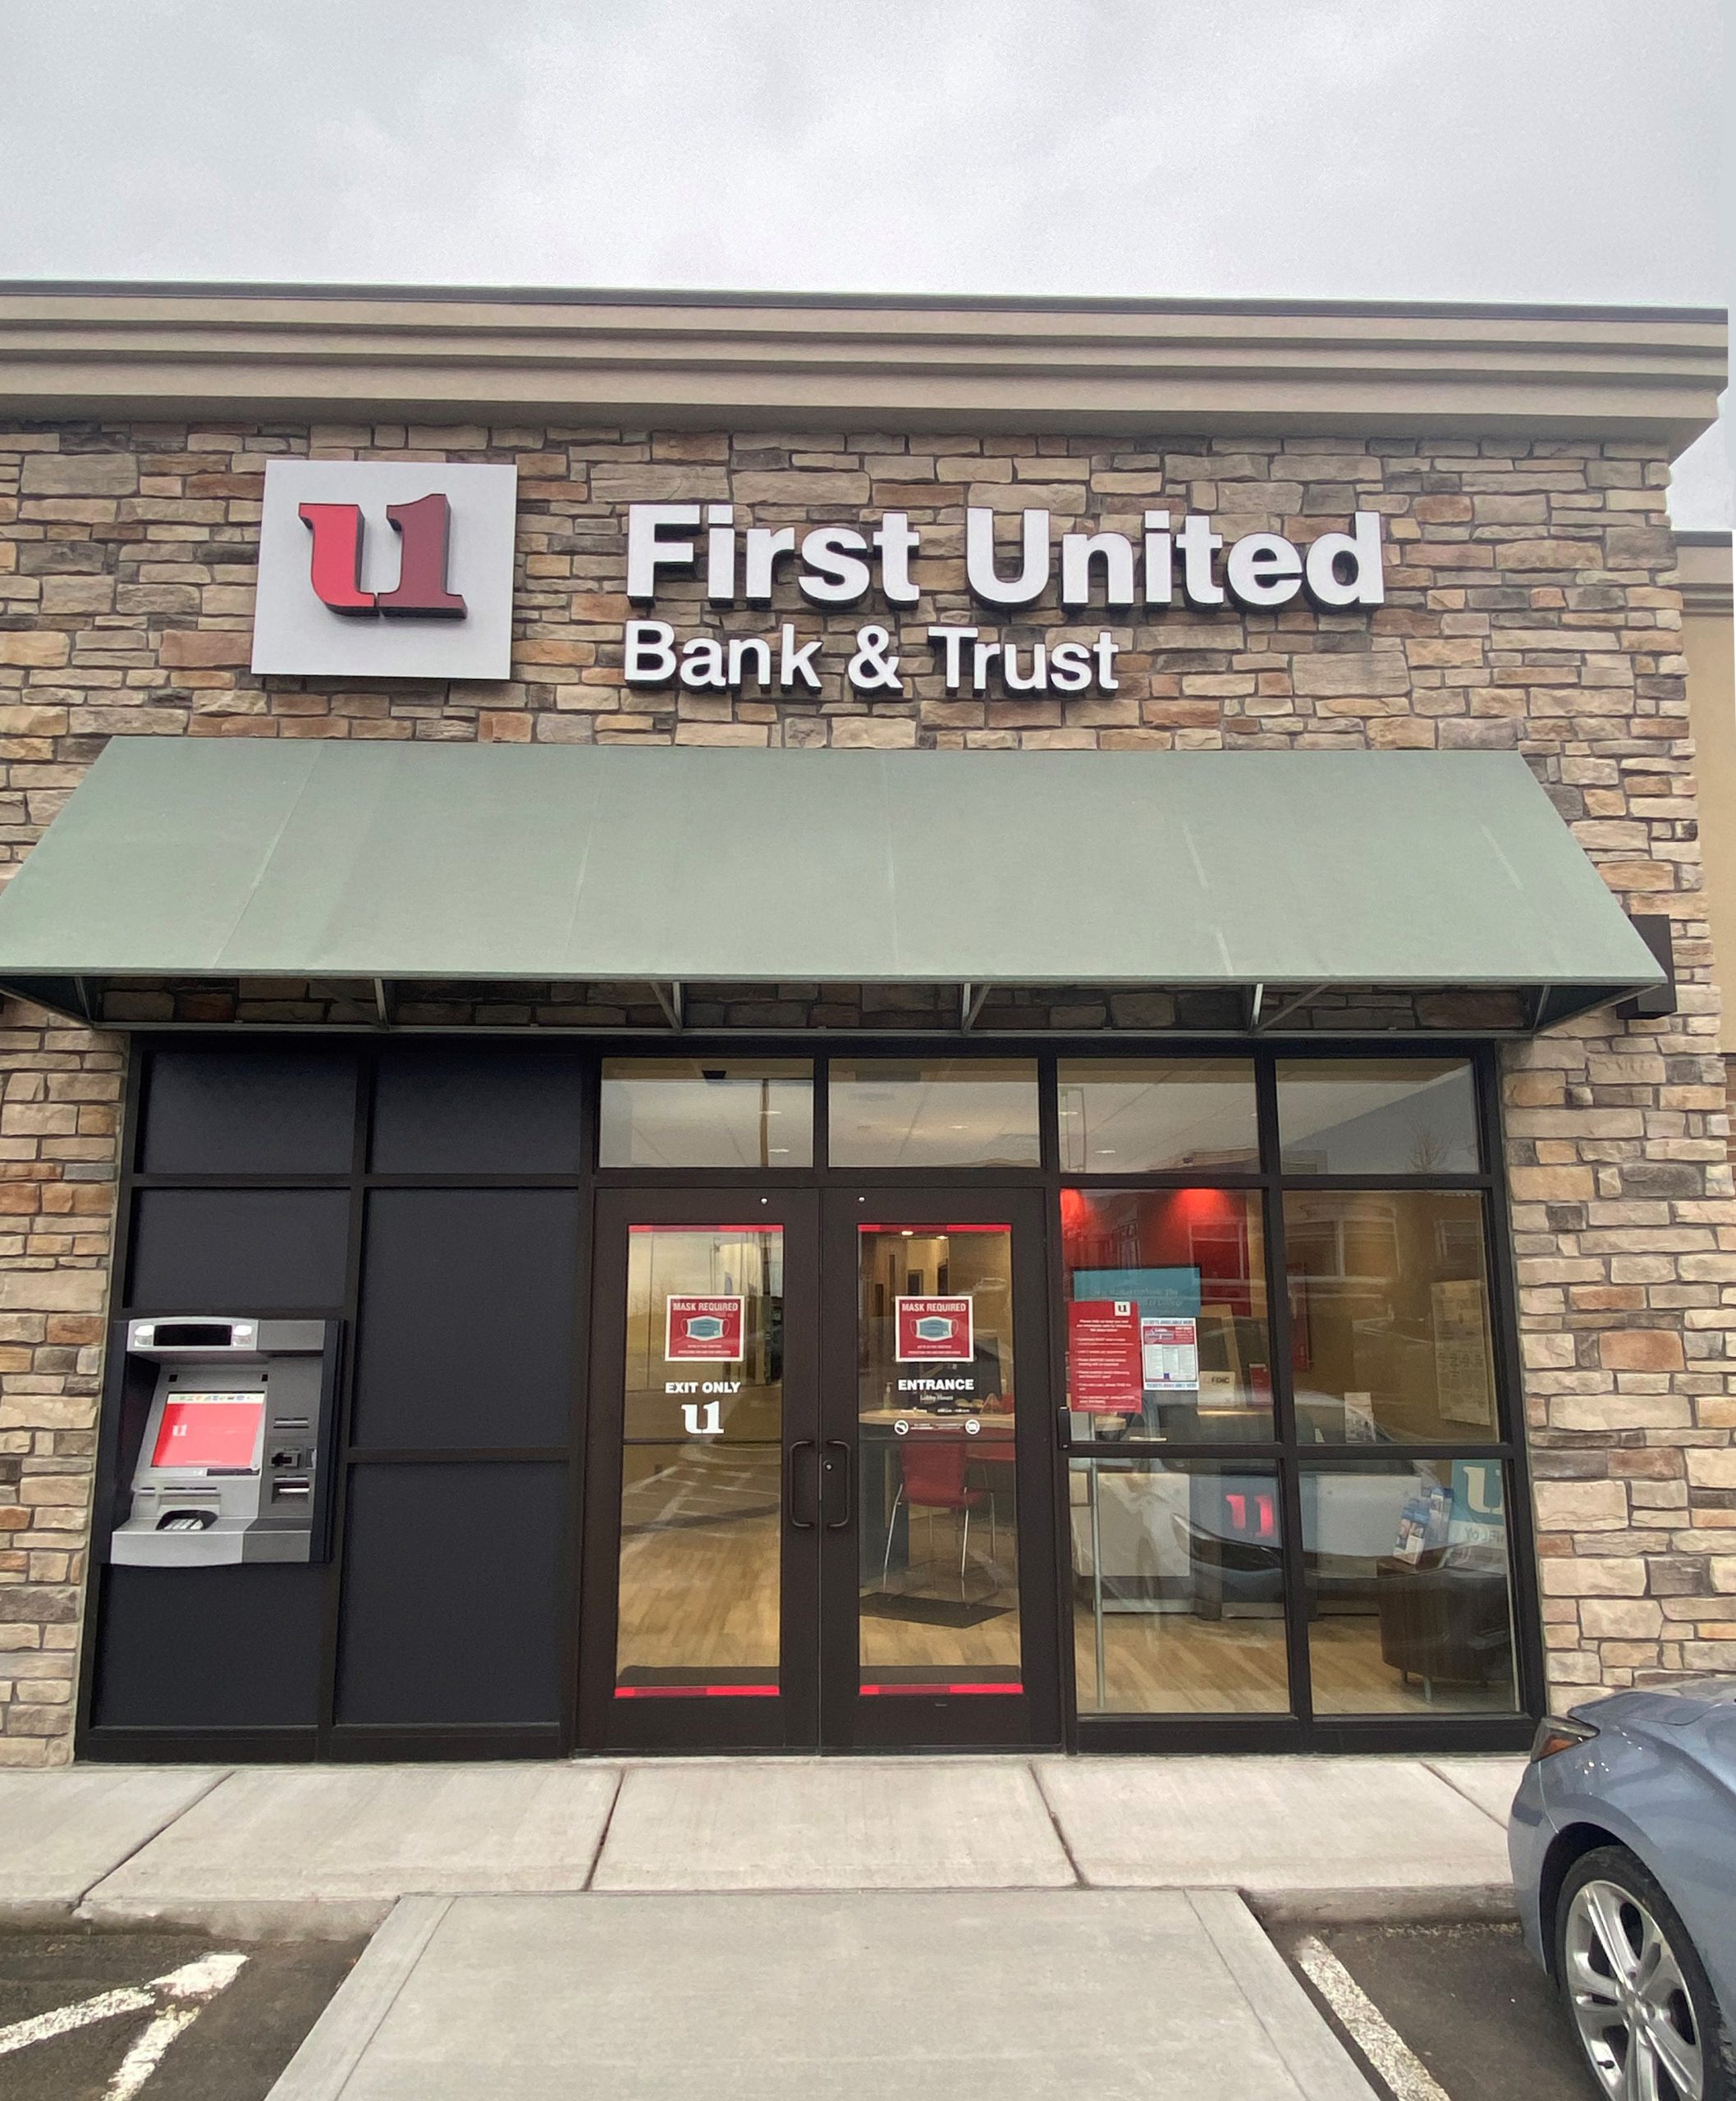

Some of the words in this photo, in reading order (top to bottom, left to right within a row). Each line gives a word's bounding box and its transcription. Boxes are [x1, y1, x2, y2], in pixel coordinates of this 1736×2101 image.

[627, 505, 921, 608] First
[966, 507, 1385, 611] United
[624, 620, 822, 693] Bank
[848, 625, 903, 693] &
[928, 625, 1120, 696] Trust
[673, 1302, 697, 1311] MASK
[698, 1302, 739, 1311] REQUIRED
[901, 1302, 925, 1312] MASK
[926, 1302, 967, 1312] REQUIRED
[665, 1381, 699, 1394] EXIT
[702, 1381, 741, 1394] ONLY
[897, 1379, 975, 1391] ENTRANCE
